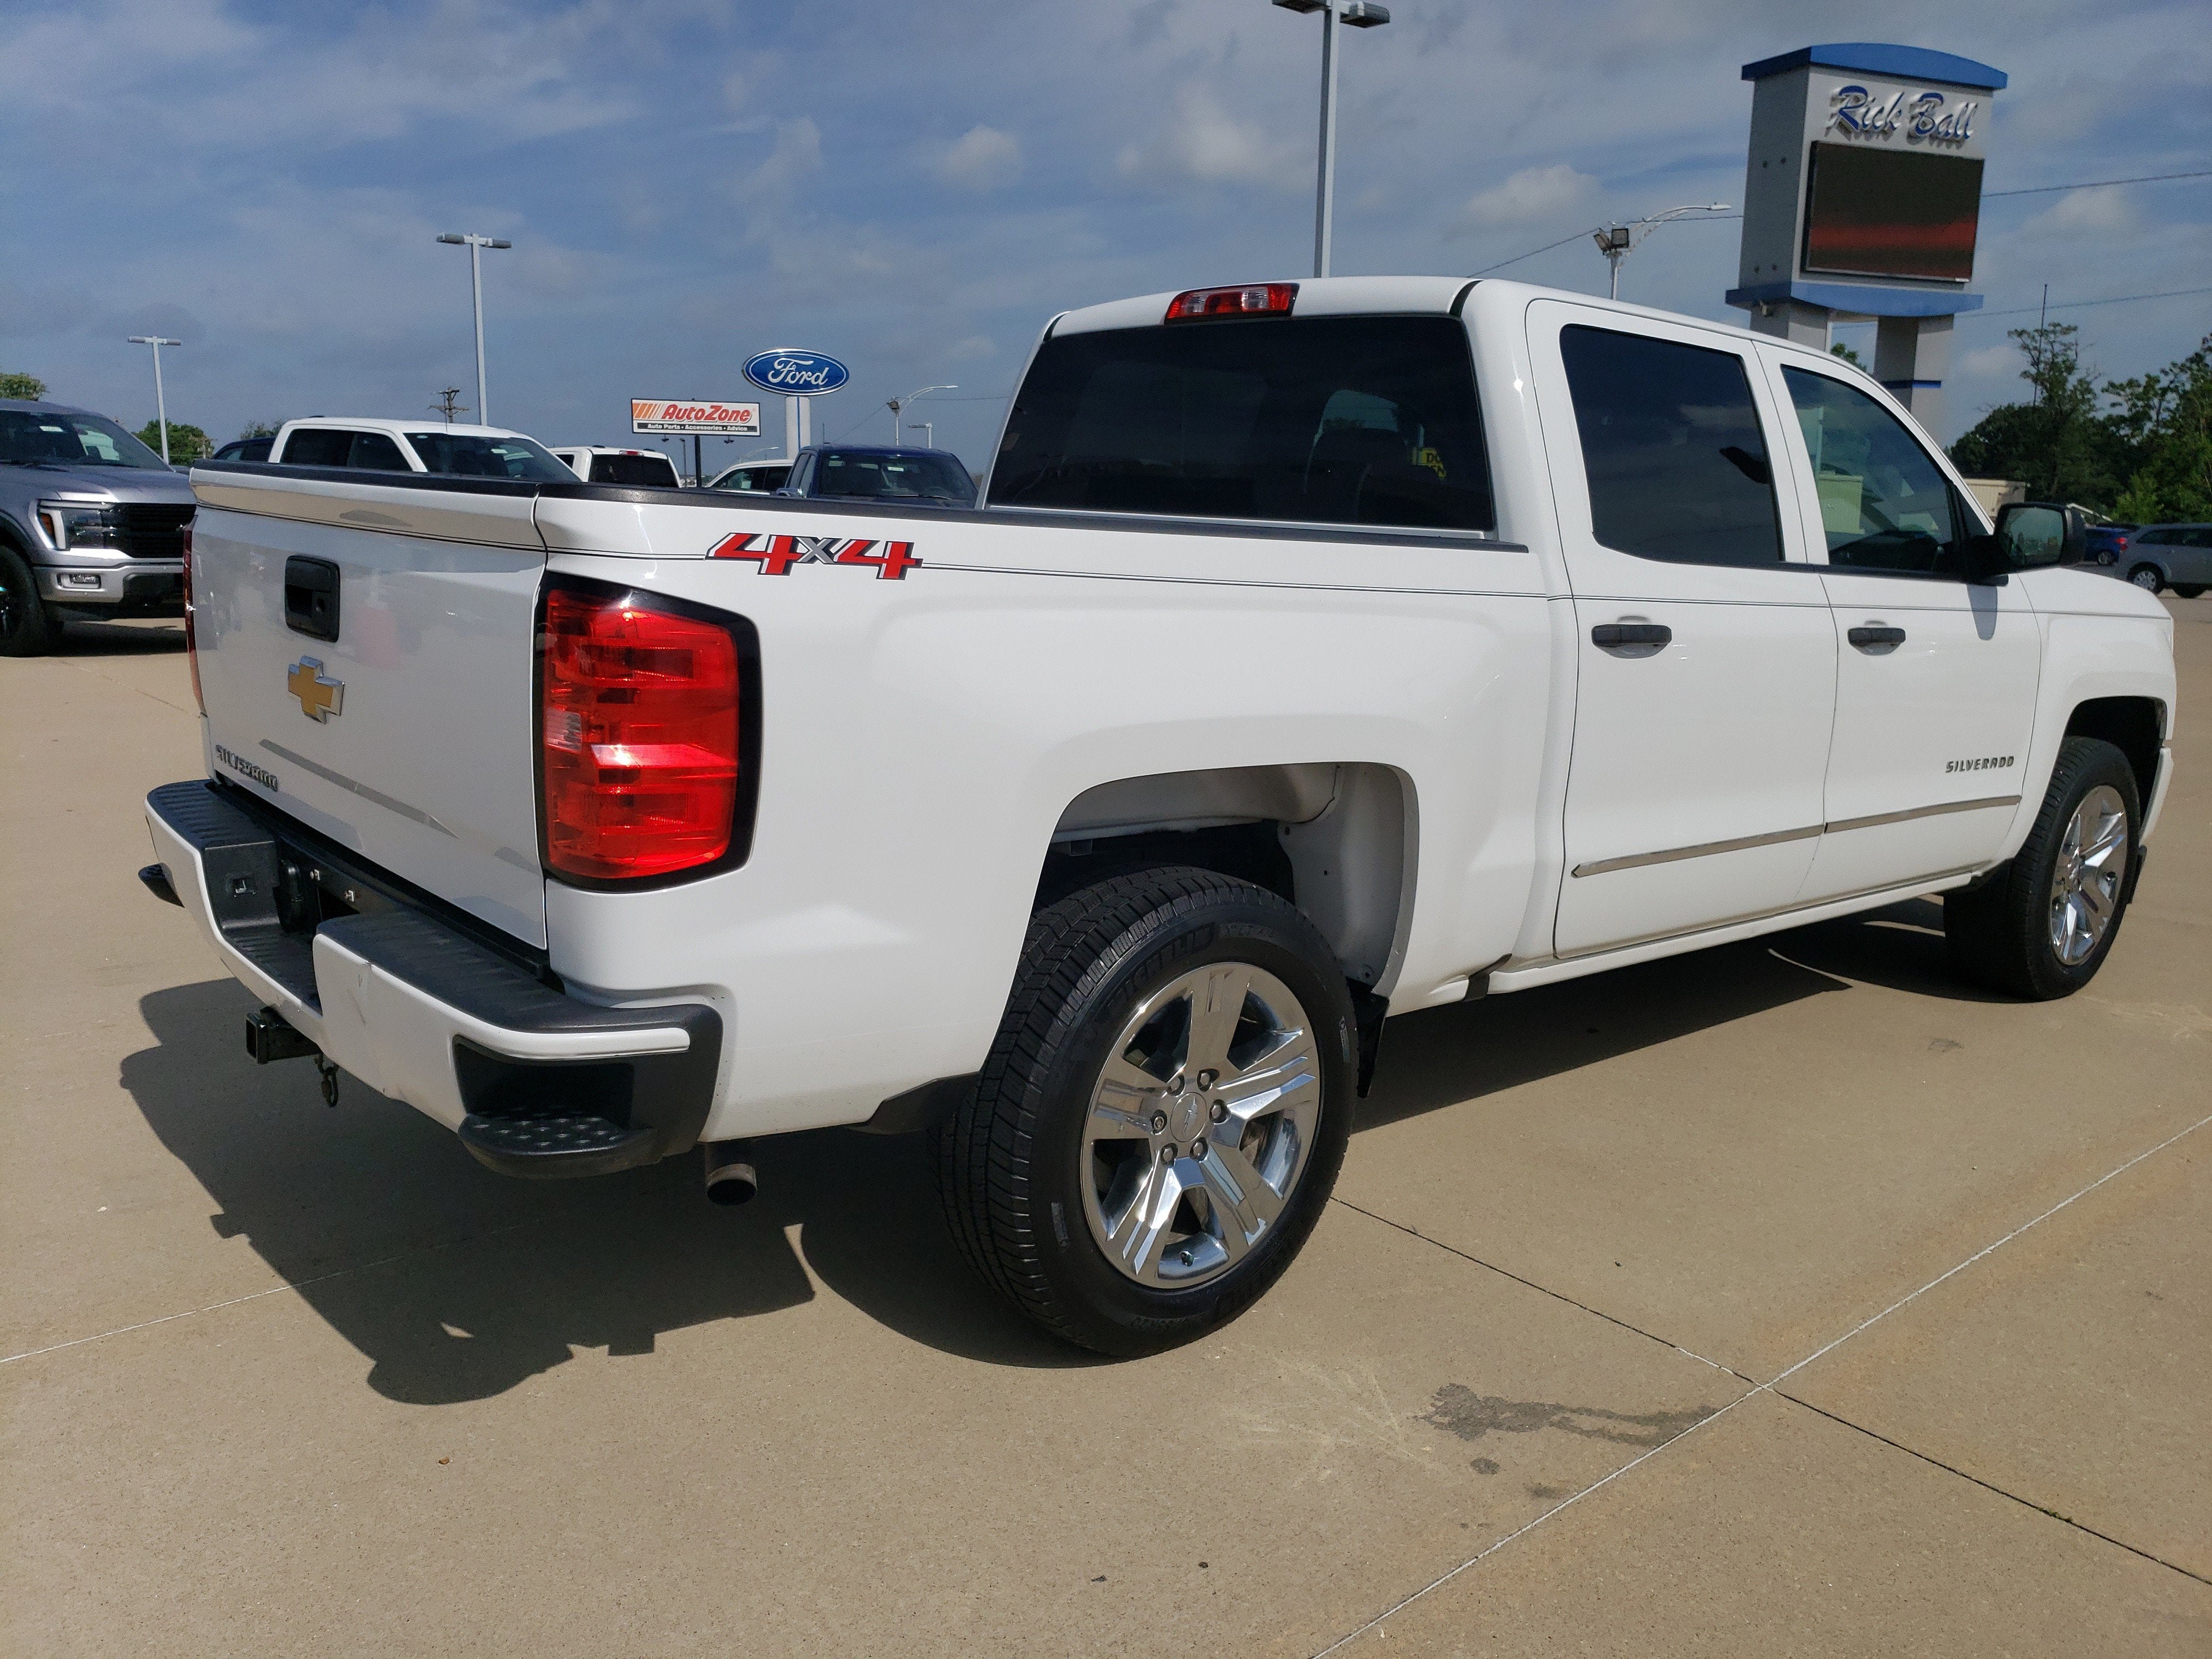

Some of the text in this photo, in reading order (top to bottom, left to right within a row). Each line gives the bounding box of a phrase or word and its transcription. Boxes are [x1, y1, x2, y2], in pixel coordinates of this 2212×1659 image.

[1830, 85, 1978, 139] Rick Ball
[768, 357, 830, 385] Ford
[661, 404, 752, 423] AutoZone
[1945, 755, 2015, 773] SILVERADO
